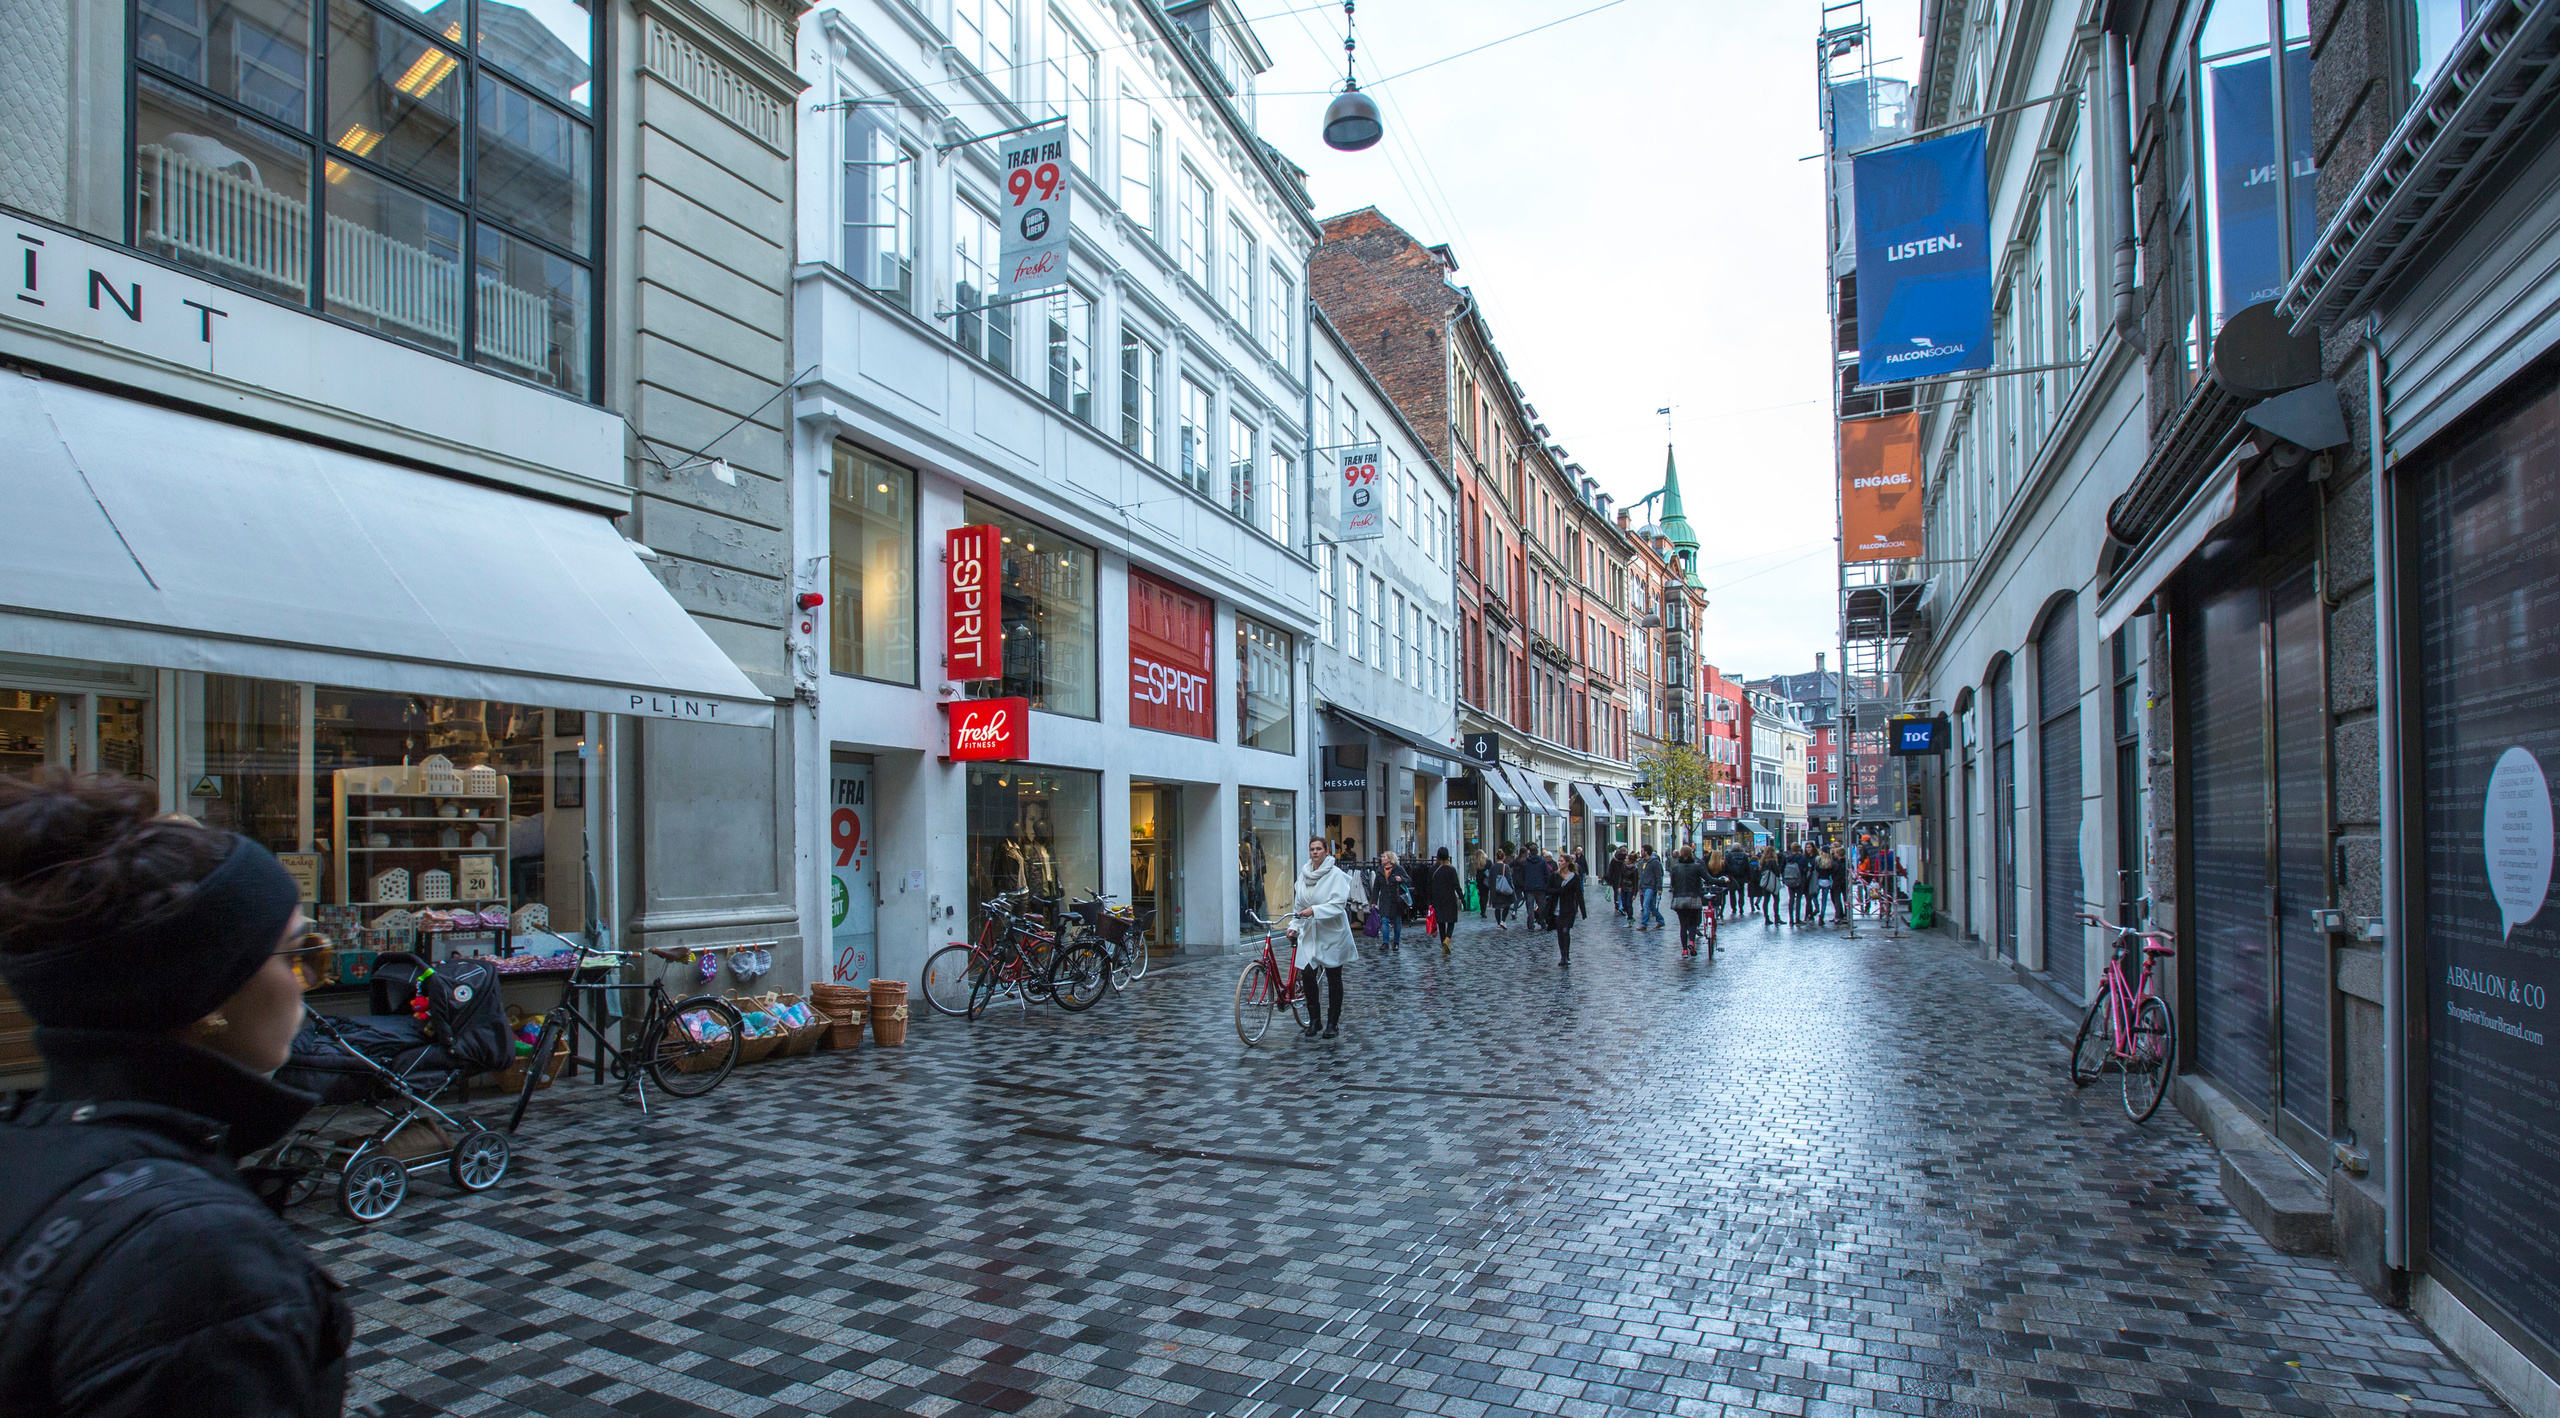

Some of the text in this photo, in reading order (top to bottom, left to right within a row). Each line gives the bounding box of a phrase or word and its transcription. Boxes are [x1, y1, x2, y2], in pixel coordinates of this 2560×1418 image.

[1008, 141, 1062, 169] TRÆN FRA
[1888, 234, 1963, 262] LISTEN.
[1013, 251, 1054, 283] fresh
[1886, 342, 1965, 364] FALCONSOCIAL
[1344, 453, 1378, 466] TRÆN FRA
[1854, 472, 1912, 489] ENGAGE.
[1349, 513, 1374, 530] fresh
[1859, 540, 1906, 551] FALCONSOCIAL
[953, 535, 982, 667] ESPRIT
[1133, 657, 1208, 715] ESPRIT
[630, 695, 720, 719] PLINT
[957, 709, 1010, 749] fresh
[1904, 732, 1930, 742] TDC
[964, 740, 996, 749] FITNESS
[839, 779, 864, 805] FRA
[1324, 779, 1366, 788] MESSAGE
[469, 877, 486, 891] 20
[2446, 965, 2546, 1010] ABSALON & CO
[2446, 1000, 2544, 1046] ShopsForYourBrand.com
